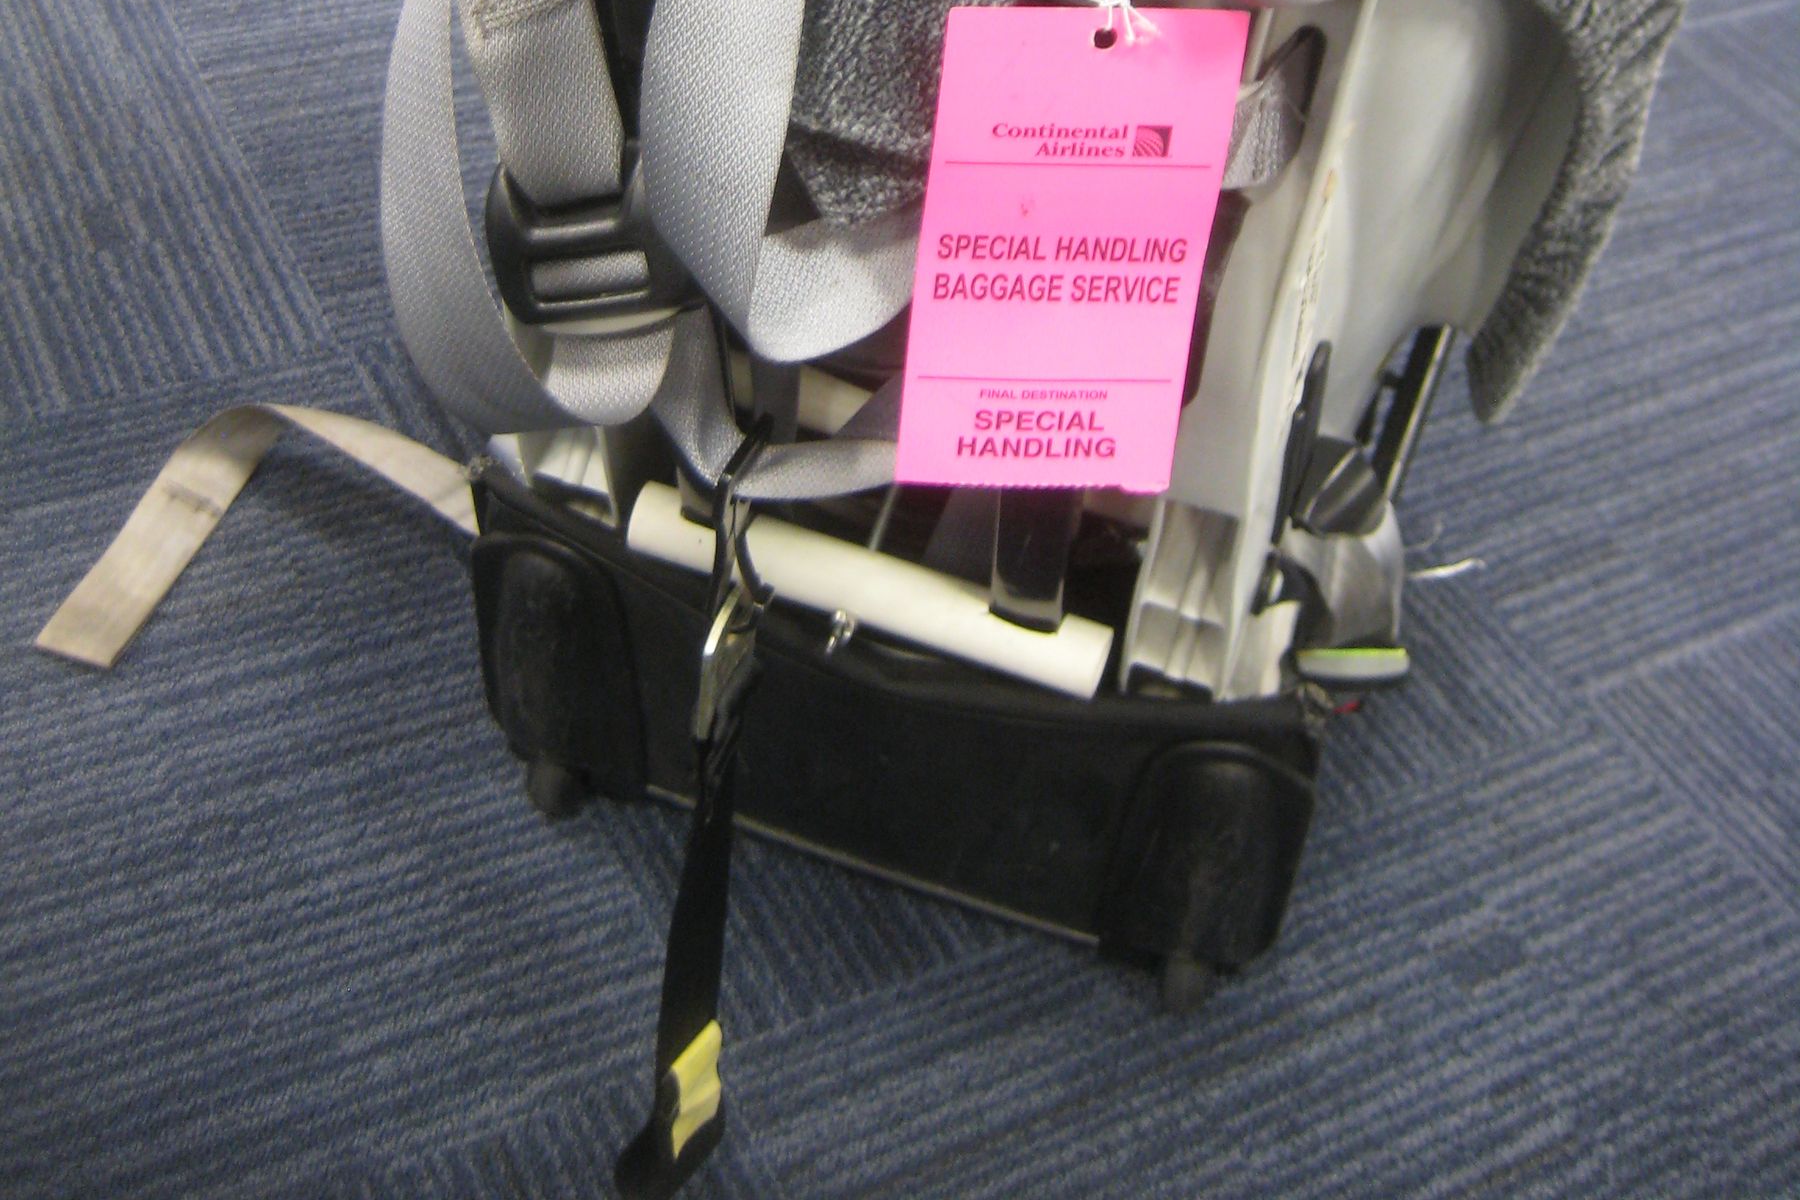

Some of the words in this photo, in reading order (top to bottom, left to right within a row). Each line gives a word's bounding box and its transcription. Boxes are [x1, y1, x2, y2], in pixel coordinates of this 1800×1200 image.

[992, 122, 1129, 140] Continental
[1034, 142, 1126, 158] Airlines
[937, 234, 1047, 261] SPECIAL
[1054, 236, 1188, 263] HANDLING
[932, 274, 1064, 302] BAGGAGE
[1070, 275, 1181, 304] SERVICE
[979, 388, 1017, 400] FINAL
[1021, 389, 1109, 400] DESTINATION
[974, 409, 1106, 432] SPECIAL
[956, 435, 1117, 459] HANDLING
